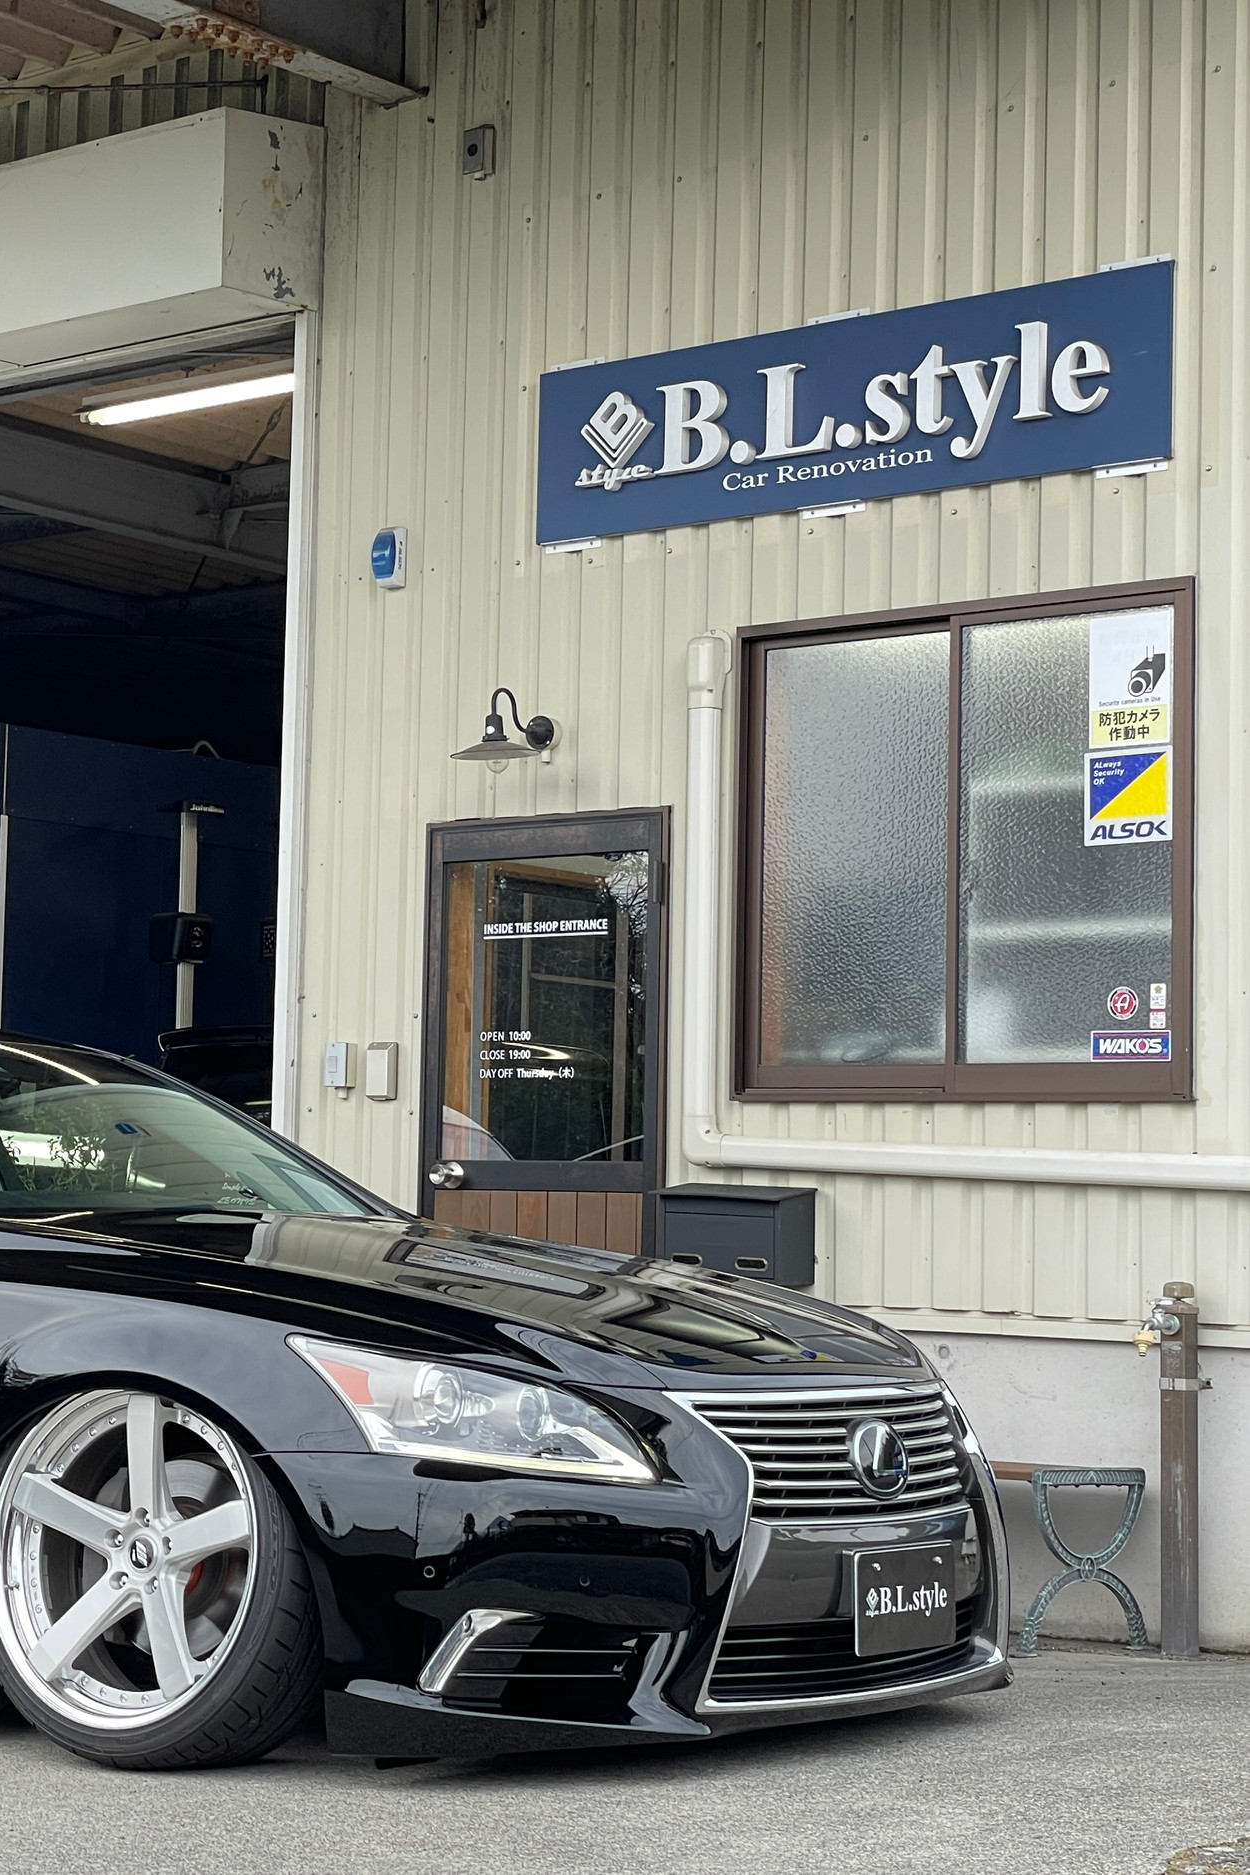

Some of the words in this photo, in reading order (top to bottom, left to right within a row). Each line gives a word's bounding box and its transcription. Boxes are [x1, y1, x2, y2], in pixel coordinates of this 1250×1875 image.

[654, 320, 1111, 477] B.L.style
[722, 472, 769, 491] Car
[776, 448, 933, 484] Renovation
[1099, 708, 1160, 727] 防犯カメラ
[1109, 724, 1149, 741] 作動中
[1093, 769, 1125, 777] Security
[1090, 820, 1168, 841] ALSOK
[483, 923, 513, 935] INSIDE
[514, 922, 532, 933] THE
[533, 921, 559, 932] SHOP
[560, 918, 608, 932] ENTRANCE
[480, 1031, 505, 1042] OPEN
[509, 1031, 531, 1041] 10:00
[480, 1049, 505, 1060] CLOSE
[509, 1049, 531, 1059] 19:00
[479, 1068, 497, 1079] DAY
[497, 1068, 513, 1079] OFF
[879, 1582, 948, 1617] B.L.style
